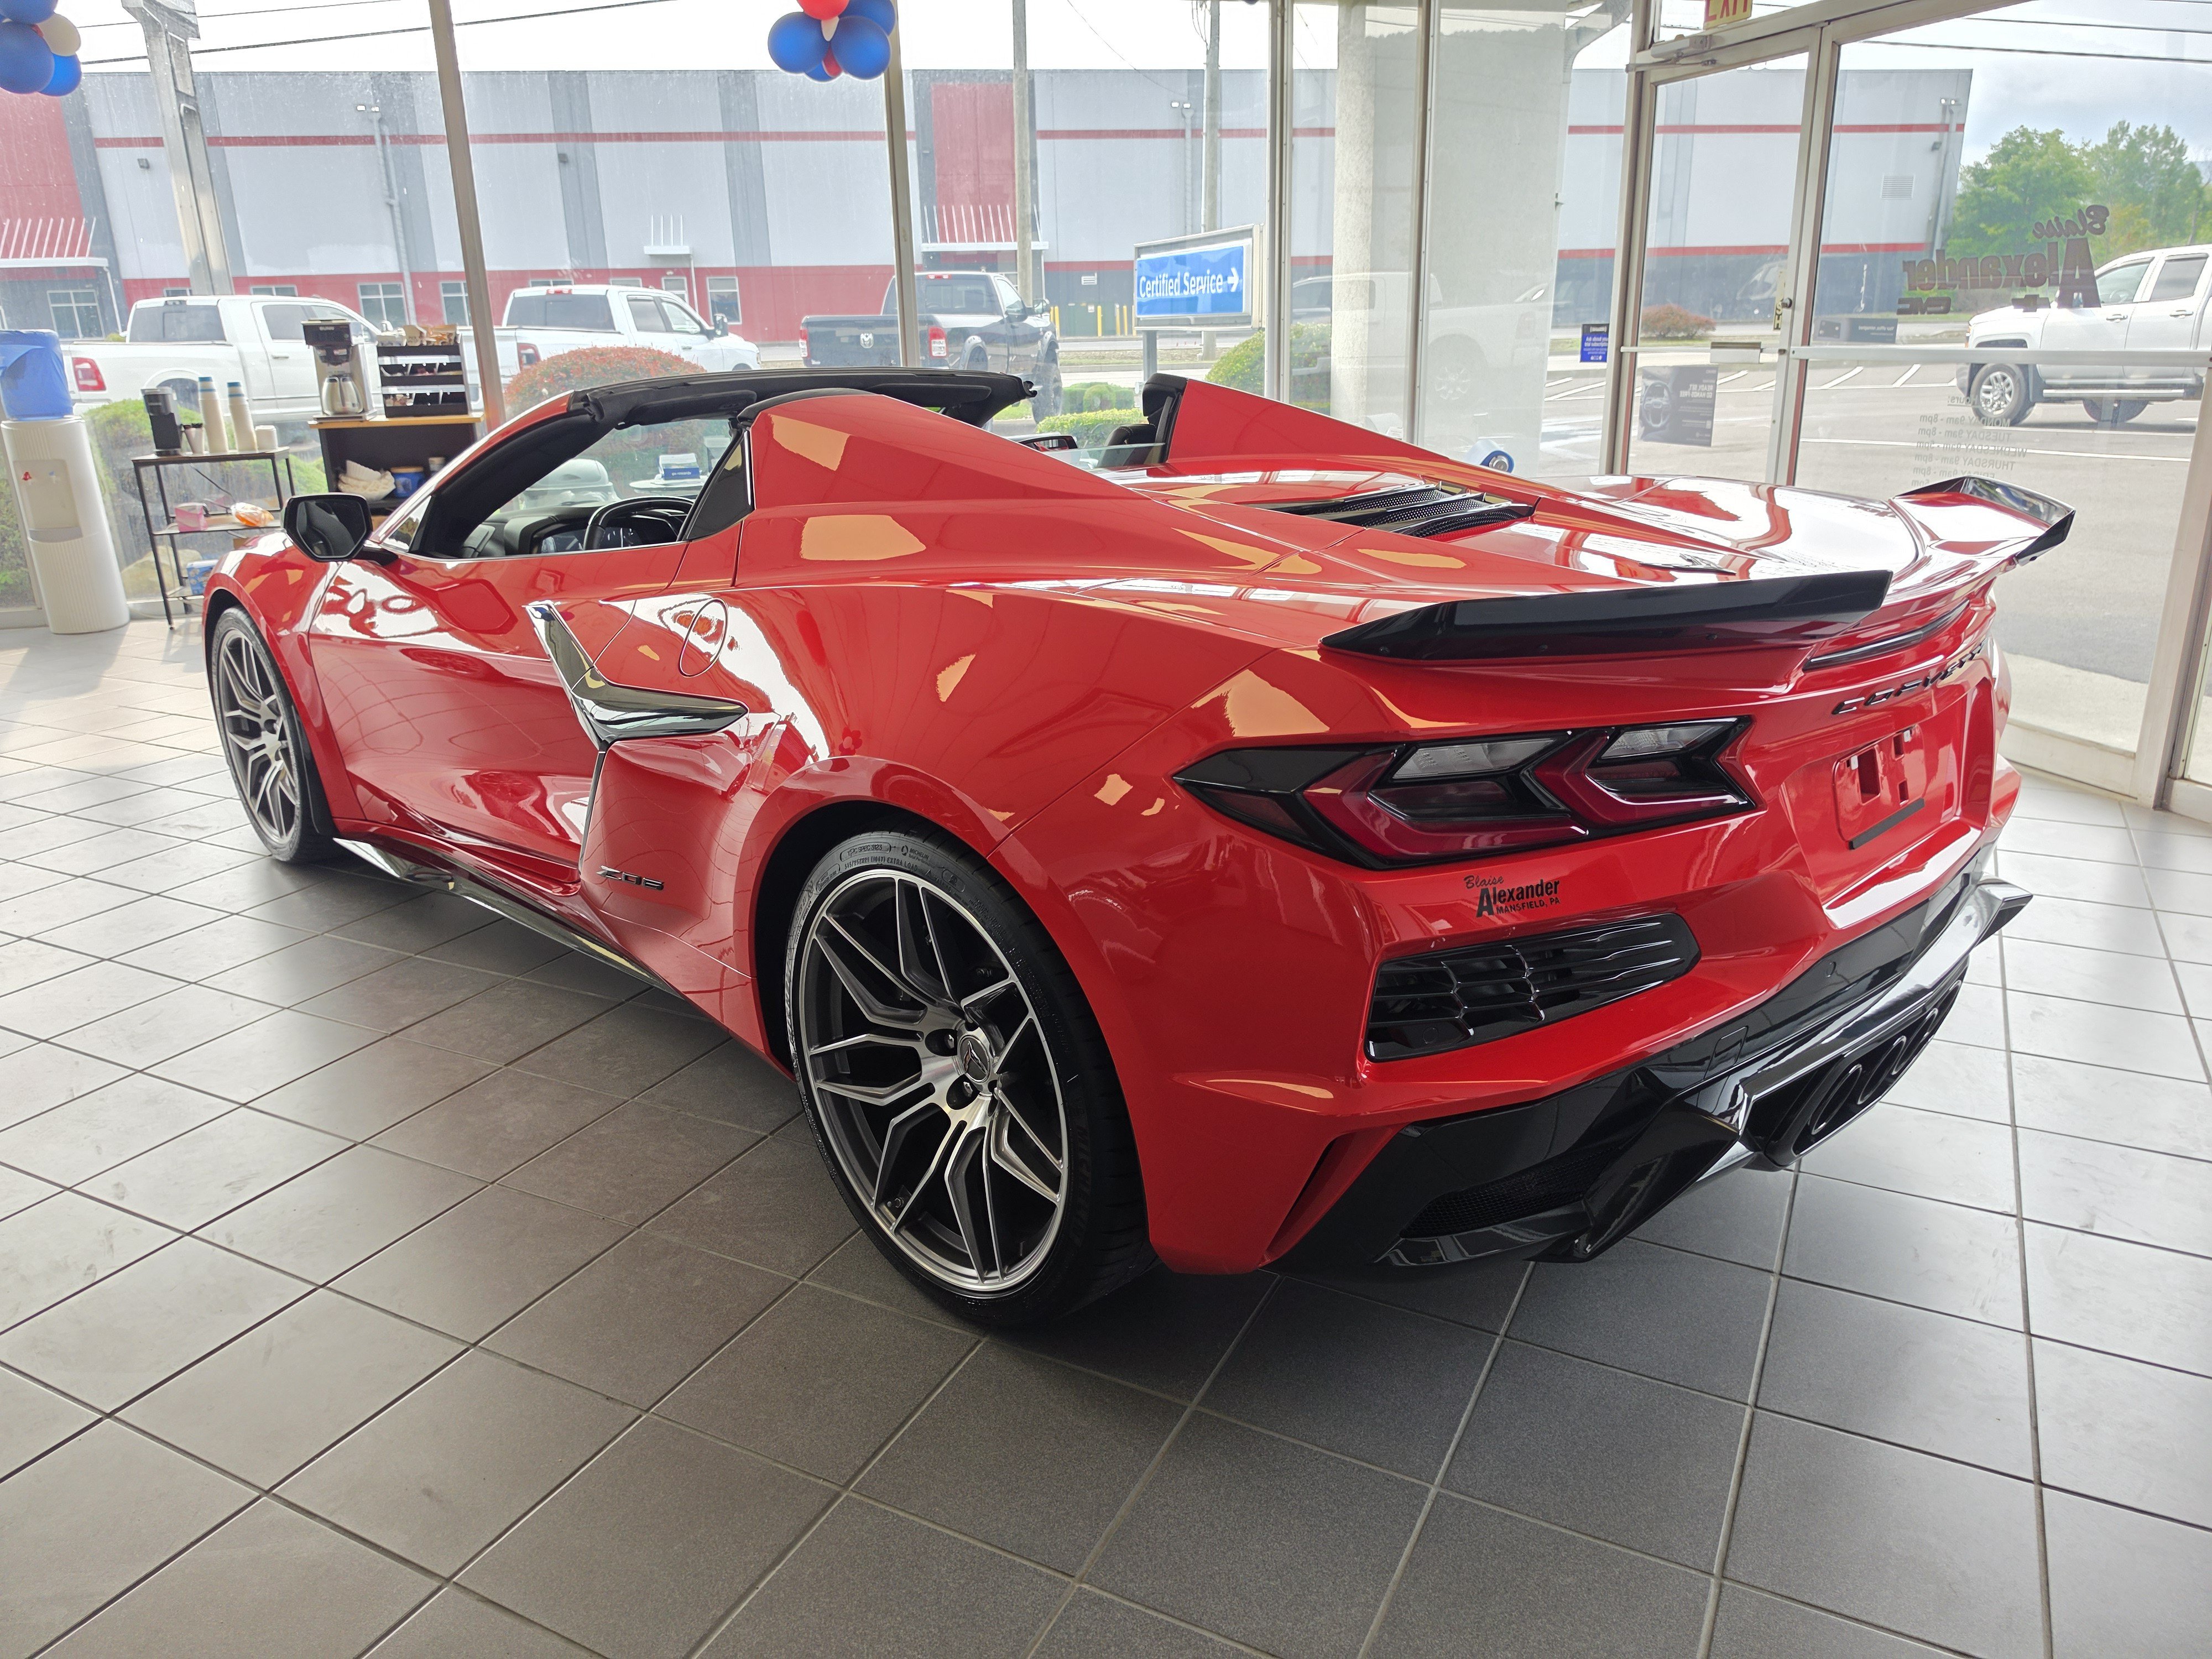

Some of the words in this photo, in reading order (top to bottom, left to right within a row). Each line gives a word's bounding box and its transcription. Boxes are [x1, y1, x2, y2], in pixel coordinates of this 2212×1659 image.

[1139, 271, 1181, 298] Certified
[1183, 269, 1223, 295] Service
[910, 848, 930, 859] MICHELIN
[886, 857, 902, 867] EXTRA
[903, 861, 918, 872] LOAD
[1463, 875, 1504, 889] Blaise
[1476, 879, 1560, 918] Alexander
[1496, 899, 1548, 914] MANSFIELD,
[1550, 897, 1561, 905] PA
